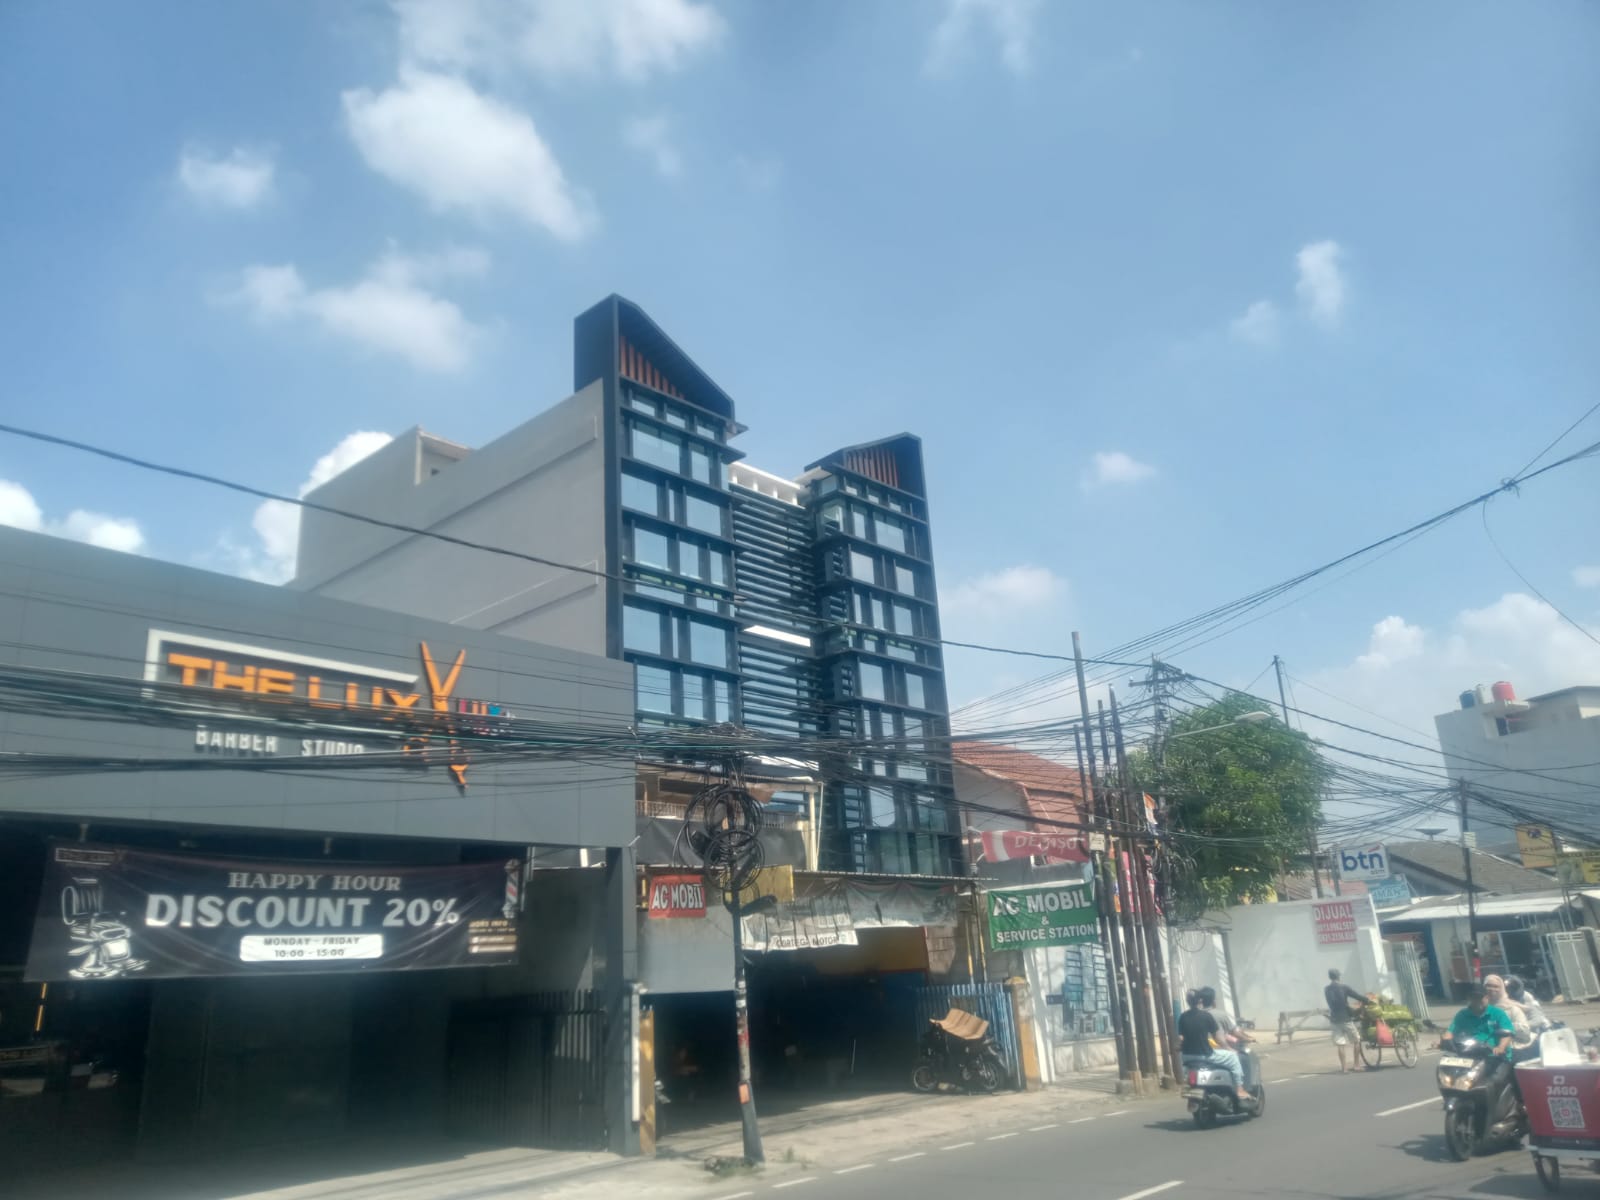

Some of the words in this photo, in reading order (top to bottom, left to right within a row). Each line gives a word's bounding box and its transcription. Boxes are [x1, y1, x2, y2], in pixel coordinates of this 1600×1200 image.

[167, 653, 297, 704] THE
[196, 724, 277, 753] BARBER
[1341, 849, 1384, 872] btn
[227, 871, 322, 890] HAPPY
[331, 875, 402, 891] HOUR
[651, 885, 669, 910] AC
[671, 883, 704, 909] MOBIL
[993, 896, 1020, 916] AC
[1026, 889, 1091, 913] MOBIL
[144, 893, 371, 928] DISCOUNT
[382, 897, 460, 928] 20%
[1041, 916, 1049, 926] &
[1314, 901, 1353, 921] DIJUAL
[264, 936, 312, 946] MONDAY
[322, 936, 360, 946] FRIDAY
[996, 928, 1046, 943] SERVICE
[1049, 923, 1095, 939] STATION
